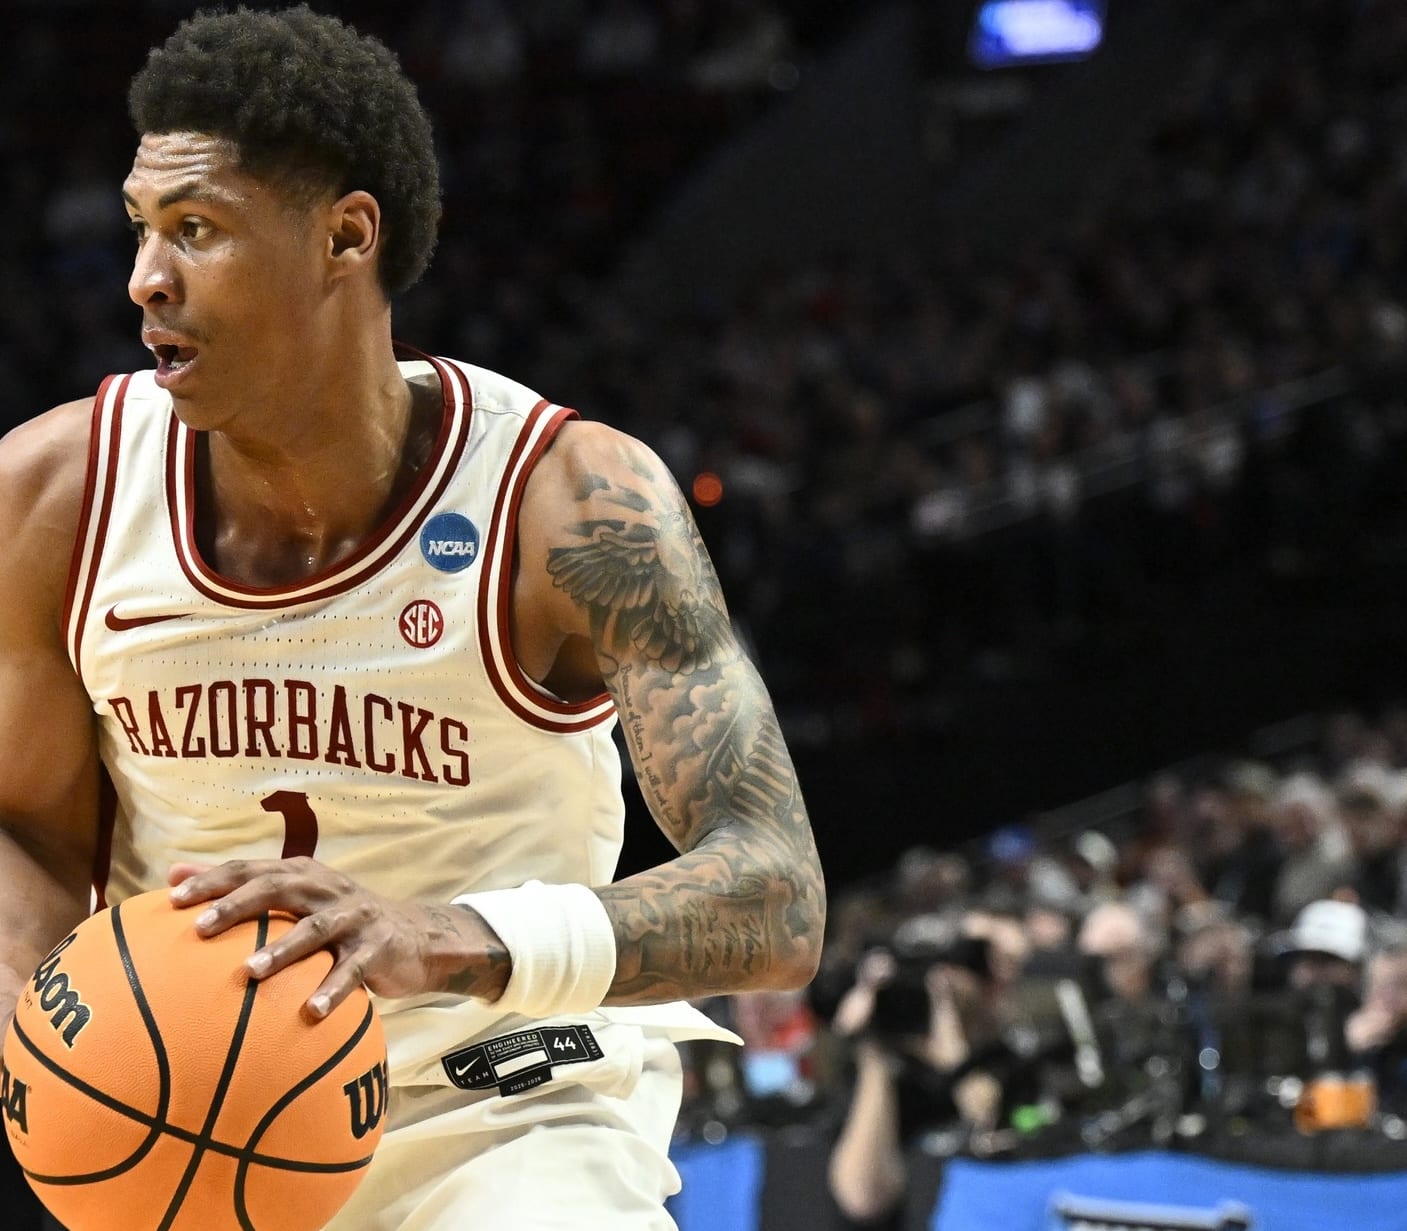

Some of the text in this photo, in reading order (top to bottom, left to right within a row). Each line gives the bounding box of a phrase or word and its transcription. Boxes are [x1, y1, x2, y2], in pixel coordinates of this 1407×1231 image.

[428, 540, 475, 557] NCAA
[403, 603, 440, 645] SEC
[107, 678, 471, 787] RAZORBACKS
[260, 790, 319, 861] 1
[487, 1034, 538, 1052] ENGINEERED
[553, 1036, 577, 1052] 44
[460, 1071, 490, 1085] TEAM
